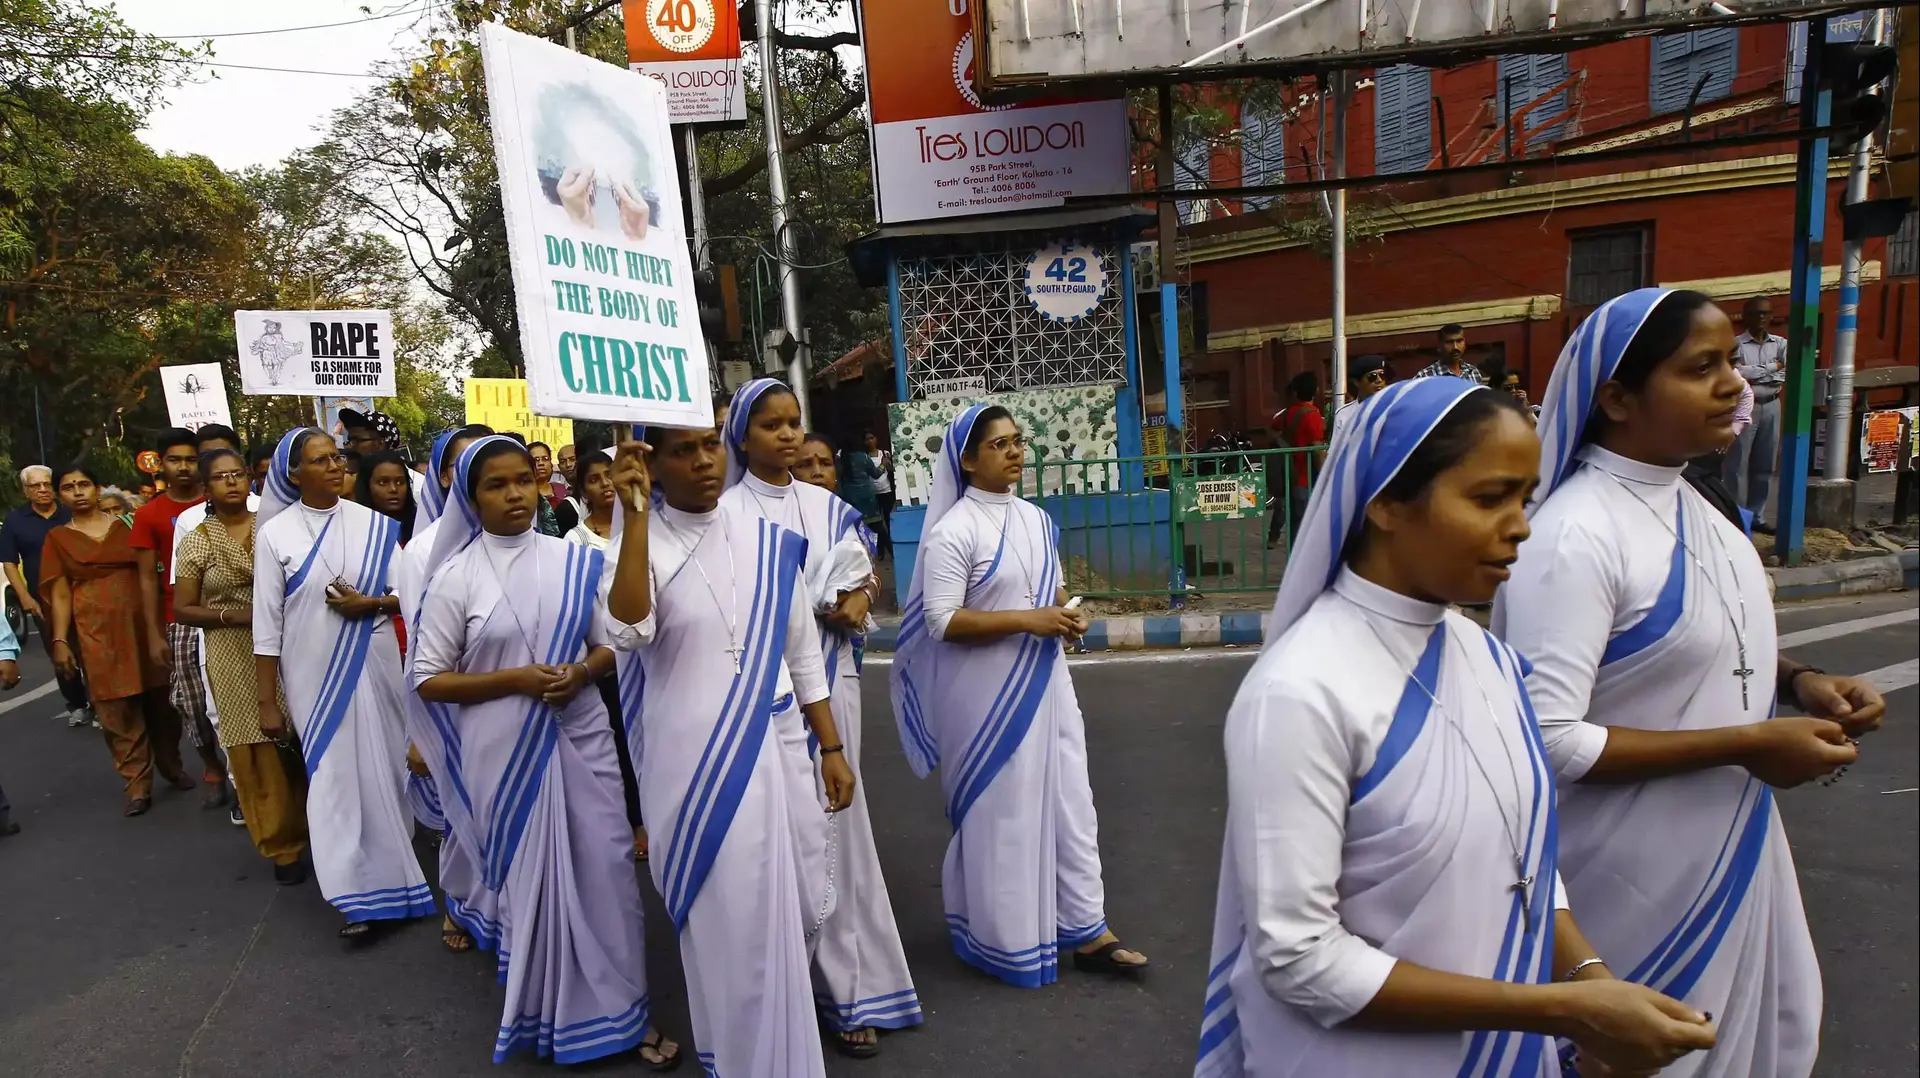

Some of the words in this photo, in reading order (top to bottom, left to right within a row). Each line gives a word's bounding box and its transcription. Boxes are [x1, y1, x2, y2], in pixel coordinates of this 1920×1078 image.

[672, 34, 693, 44] OFF
[915, 126, 968, 163] Tres
[970, 165, 986, 173] 95B
[988, 162, 1007, 172] Park
[1009, 161, 1035, 170] Street,
[963, 174, 995, 185] Ground
[997, 173, 1020, 182] Floor,
[1022, 169, 1053, 179] Kolkata
[1062, 167, 1073, 175] 16
[972, 186, 989, 195] Tel.:
[991, 183, 1013, 193] 4006
[1015, 181, 1036, 191] 8006
[938, 199, 968, 209] E-mail:
[969, 189, 1073, 206] tresloudon@hotmail.com
[544, 234, 576, 269] DO
[580, 240, 620, 277] NOT
[624, 250, 673, 287] HURT
[1044, 257, 1087, 283] 42
[1036, 284, 1061, 293] SOUTH
[1072, 284, 1097, 293] GUARD
[551, 279, 594, 316] THE
[597, 286, 651, 324] BODY
[656, 297, 679, 328] OF
[310, 321, 380, 357] RAPE
[310, 360, 321, 373] IS
[322, 360, 329, 373] A
[330, 361, 363, 373] SHAME
[364, 361, 382, 374] FOR
[558, 331, 692, 403] CHRIST
[315, 373, 335, 386] OUR
[336, 373, 379, 386] COUNTRY
[926, 383, 945, 394] BEAT
[1213, 482, 1236, 493] EXCESS
[1204, 494, 1215, 504] FAT
[1215, 493, 1231, 503] NOW
